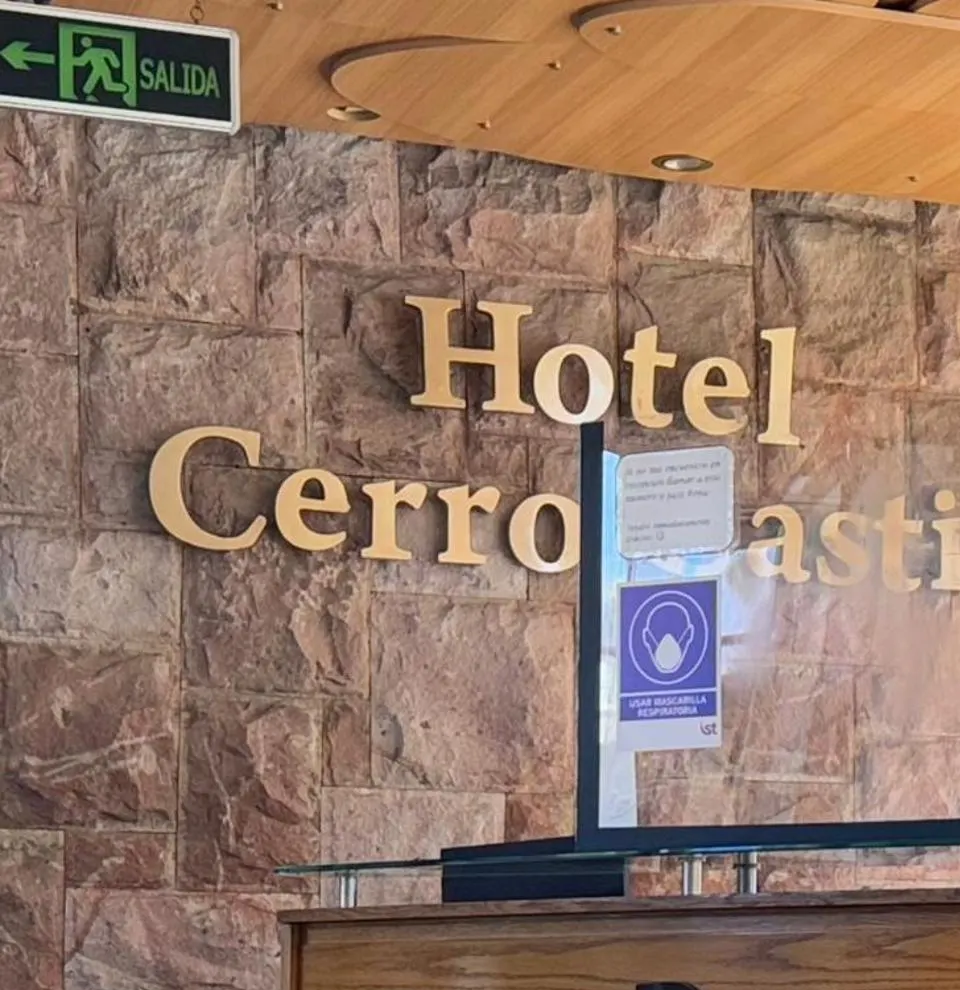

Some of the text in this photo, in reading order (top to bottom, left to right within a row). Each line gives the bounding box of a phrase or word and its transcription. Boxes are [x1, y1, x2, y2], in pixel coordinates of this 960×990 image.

[140, 57, 221, 98] SALIDA
[405, 295, 802, 446] Hotel
[149, 425, 581, 574] Cerro
[628, 694, 708, 709] USAR MASCARILLA
[637, 705, 698, 718] RESPIRATORIA
